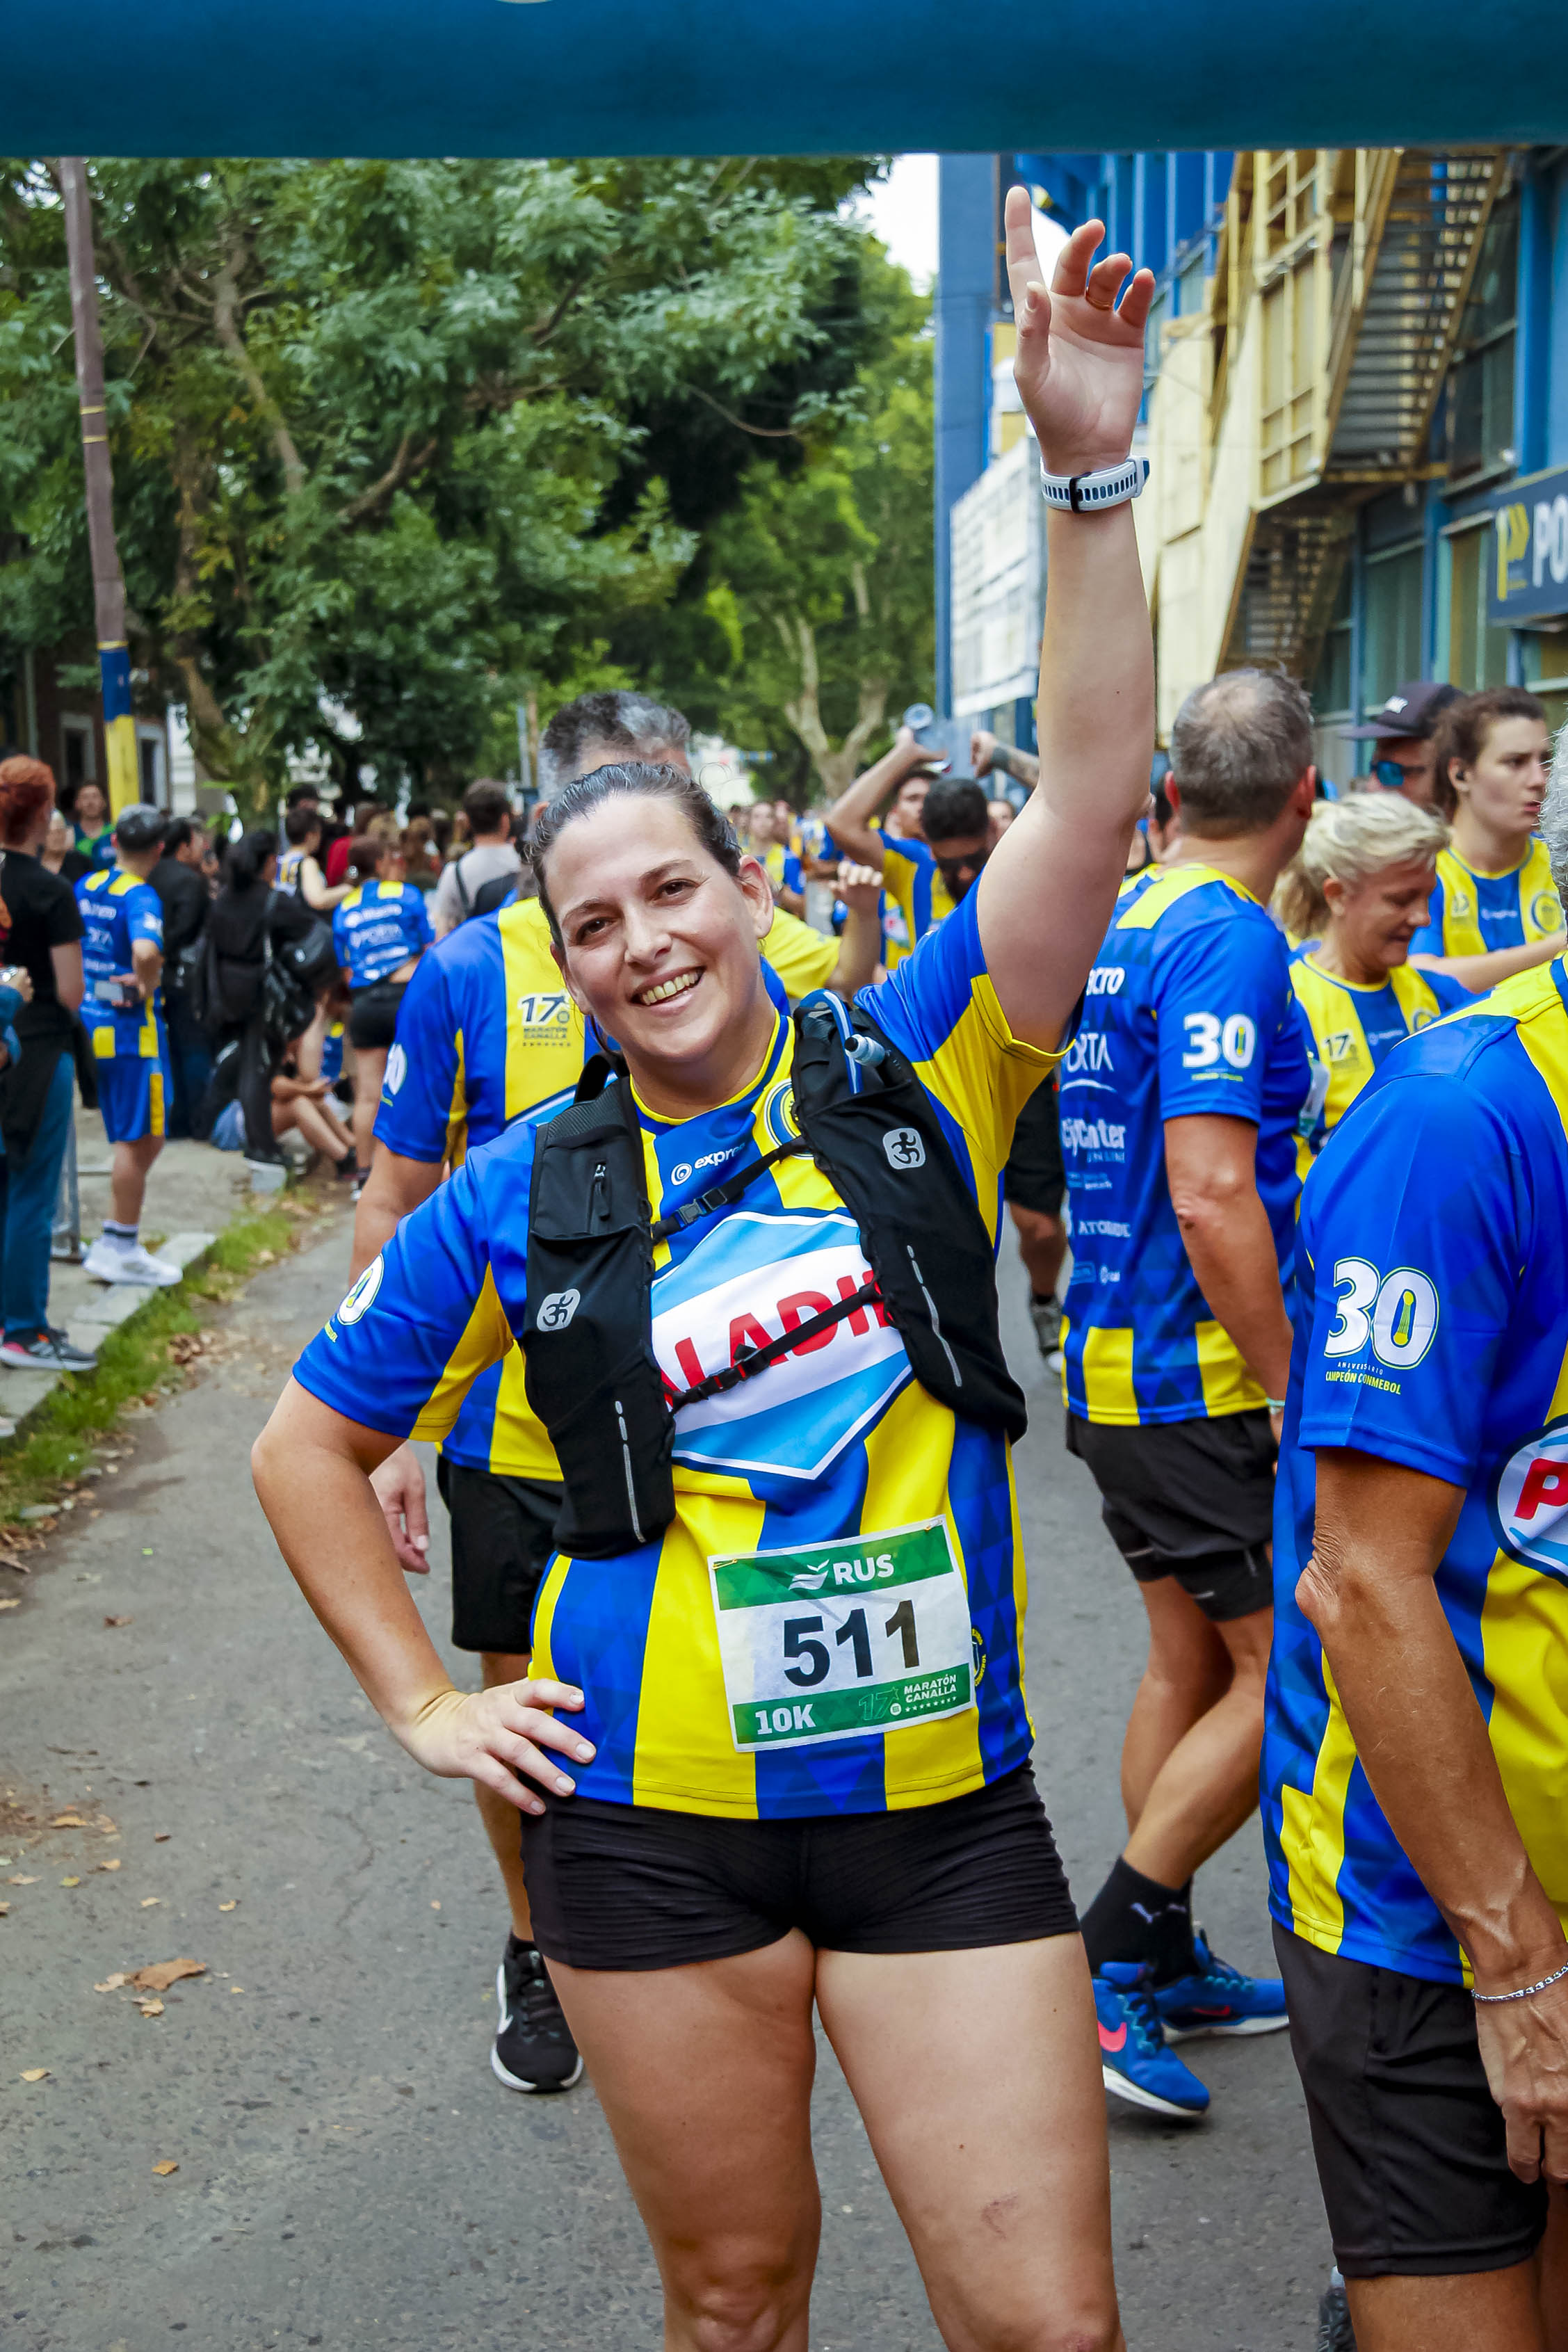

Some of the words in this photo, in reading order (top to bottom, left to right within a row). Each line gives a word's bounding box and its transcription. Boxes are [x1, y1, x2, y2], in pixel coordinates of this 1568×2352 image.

[1183, 1010, 1256, 1069] 30
[1323, 1256, 1439, 1369] 30
[661, 1269, 893, 1408] LADI
[832, 1554, 894, 1586] RUS
[783, 1600, 920, 1687] 511
[903, 1673, 957, 1695] MARATÓN
[905, 1684, 957, 1703] CANALLA
[755, 1703, 816, 1735] 10K
